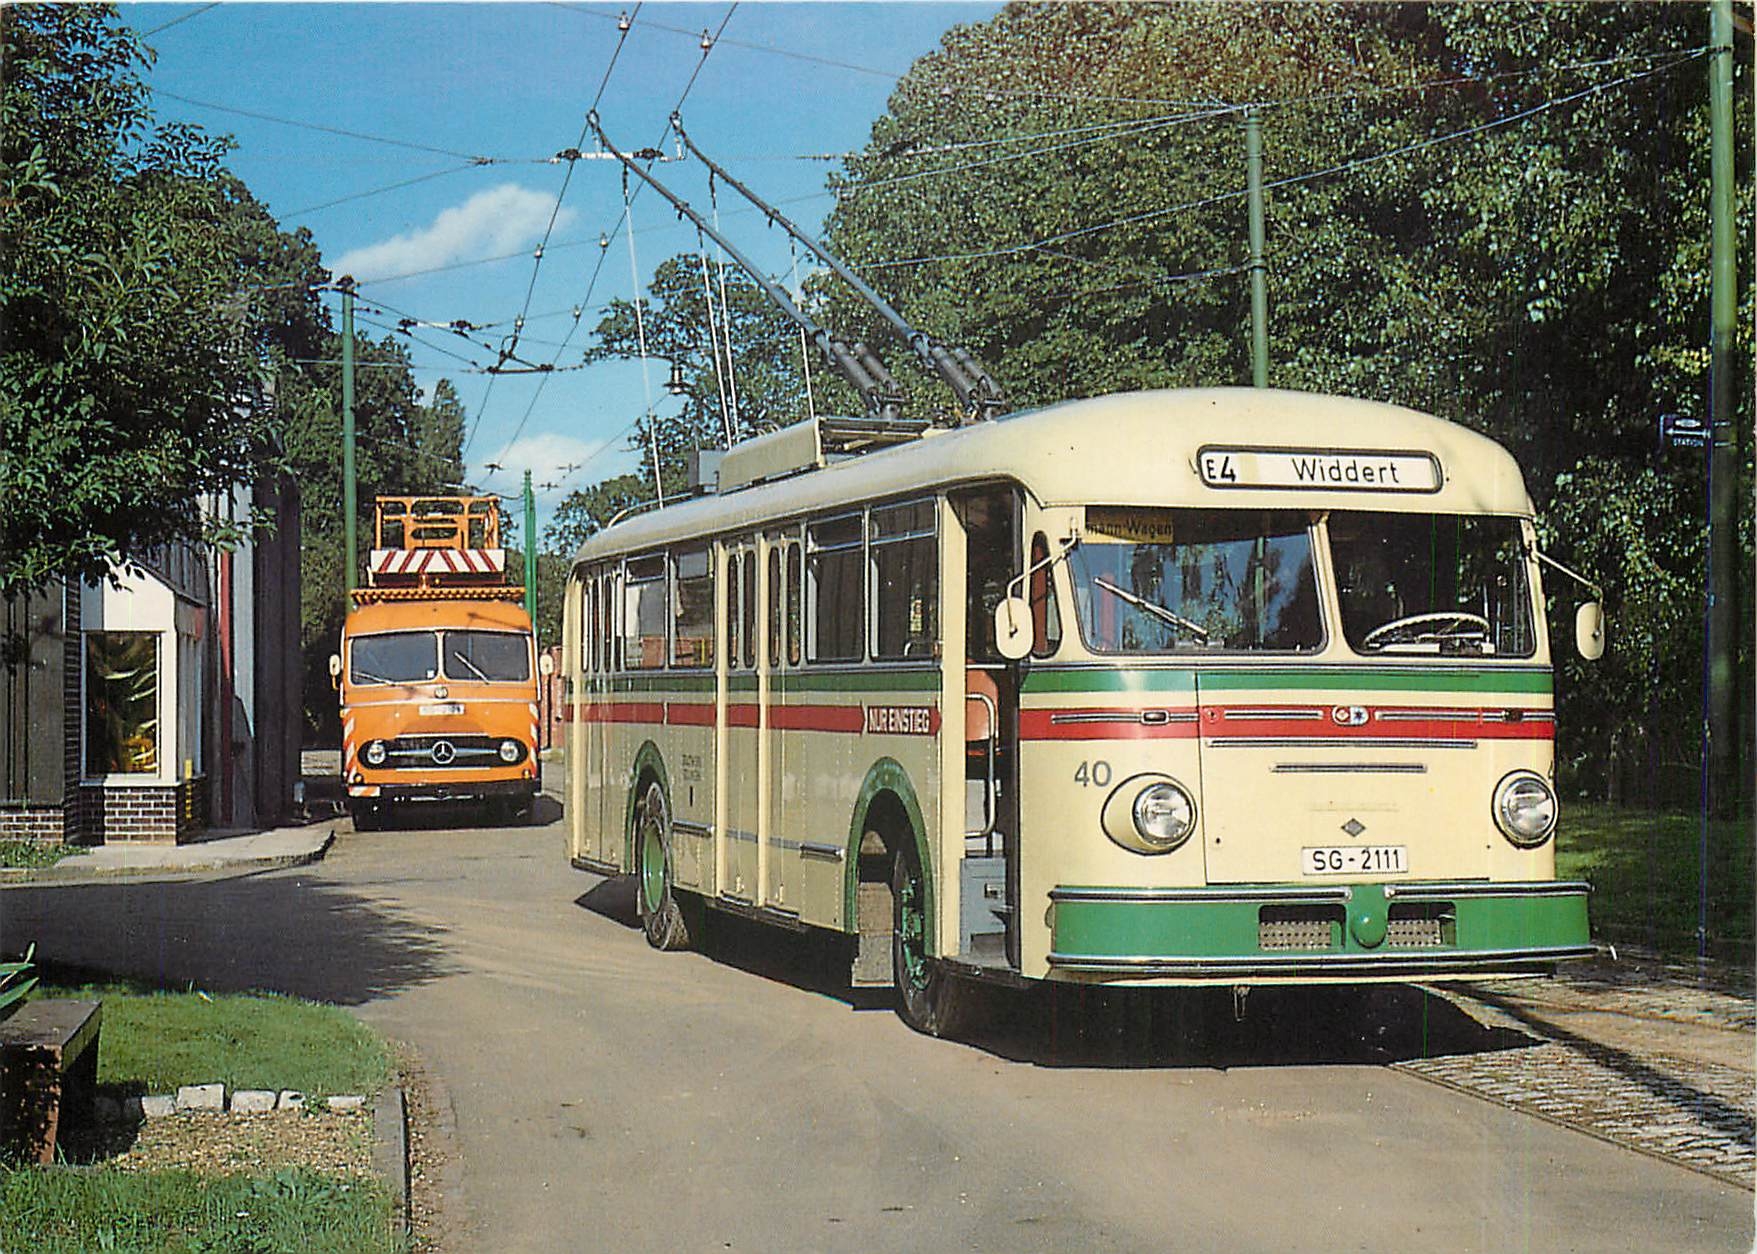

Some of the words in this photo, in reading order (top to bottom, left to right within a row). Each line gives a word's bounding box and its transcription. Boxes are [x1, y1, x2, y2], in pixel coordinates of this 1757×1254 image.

[1205, 455, 1237, 483] E4
[1291, 458, 1400, 484] Widdert
[869, 708, 888, 732] NUR
[889, 708, 931, 733] EINSTIEG
[1073, 760, 1113, 788] 40
